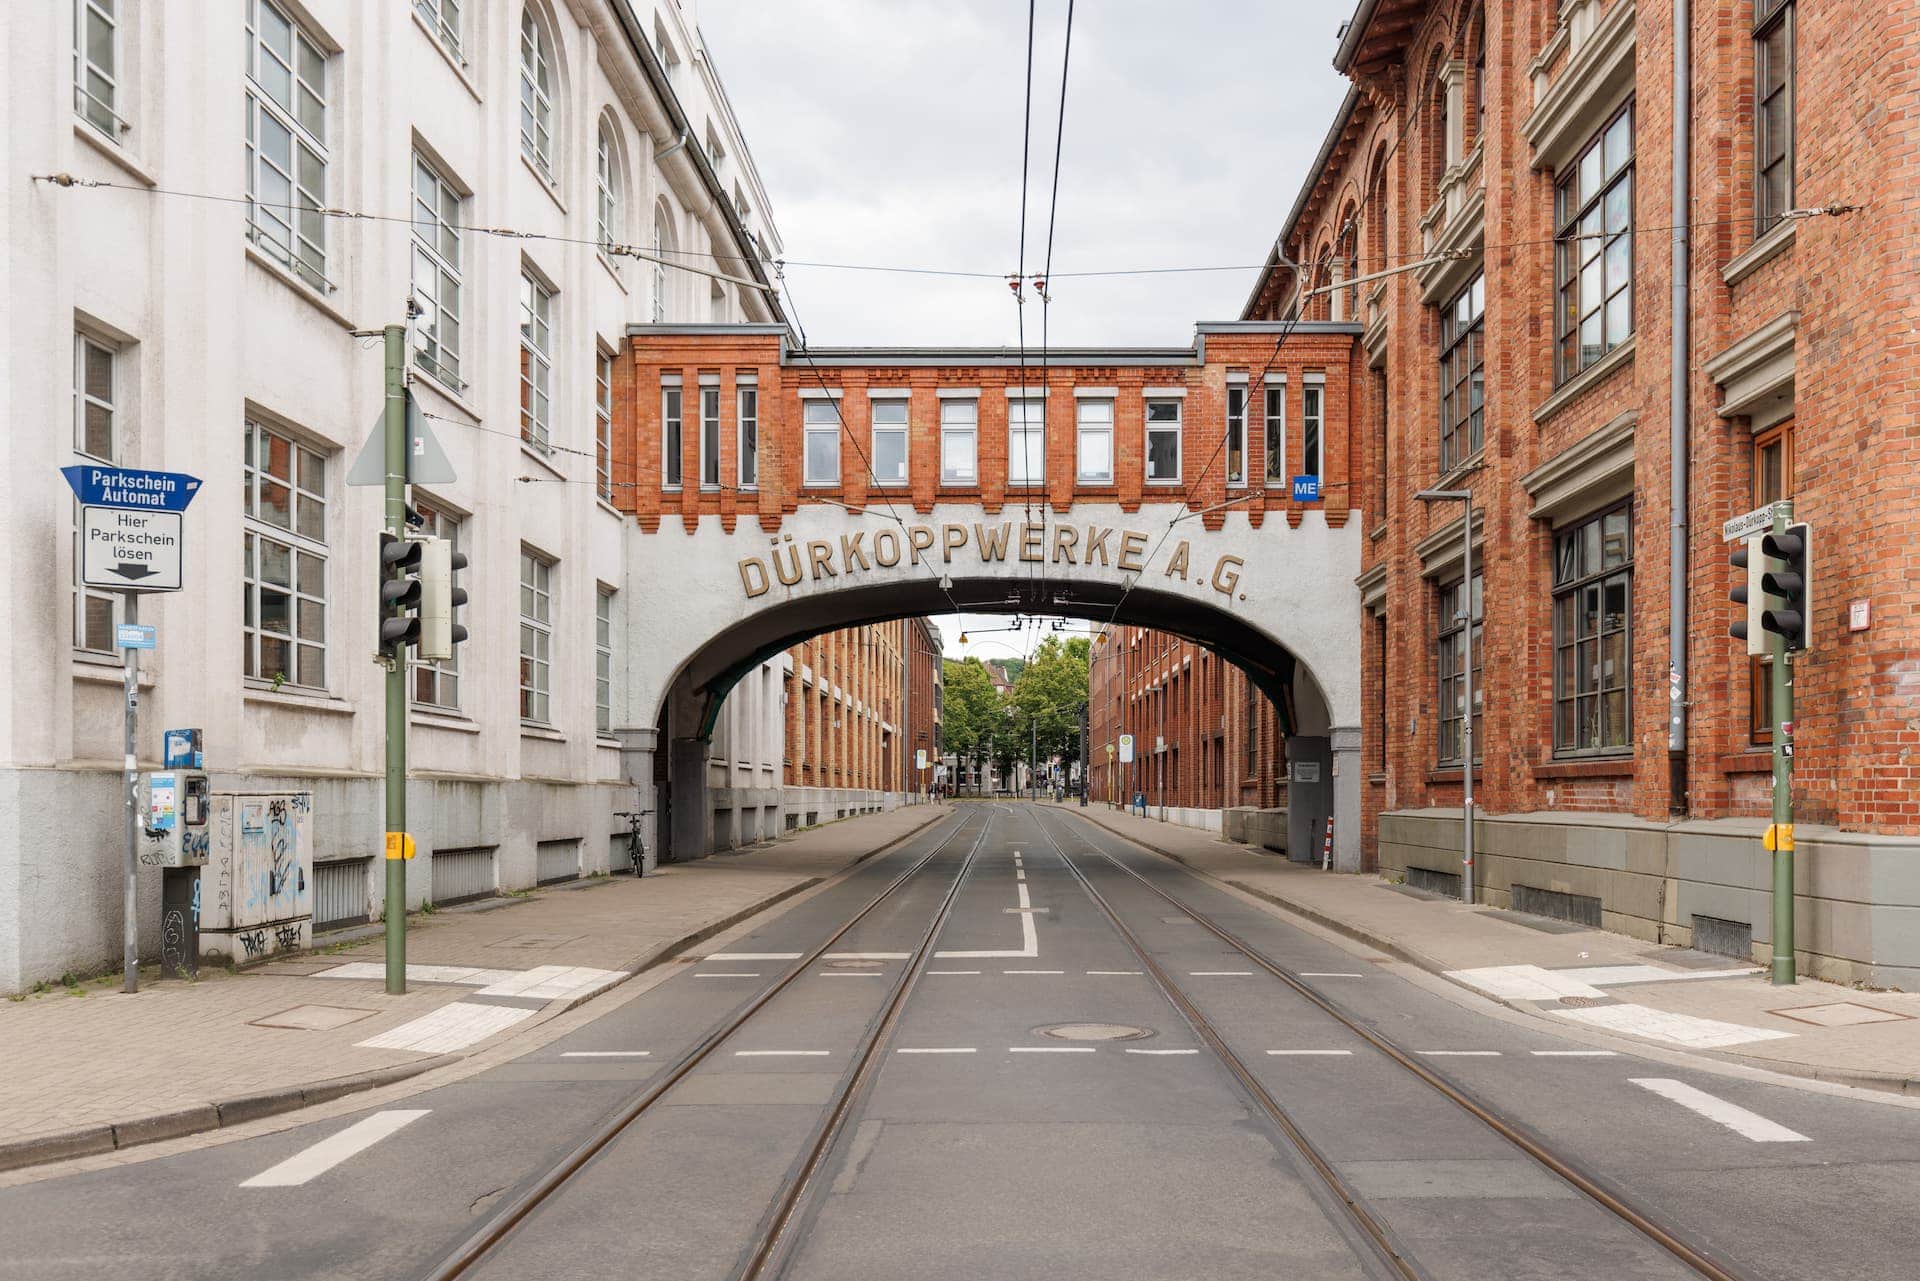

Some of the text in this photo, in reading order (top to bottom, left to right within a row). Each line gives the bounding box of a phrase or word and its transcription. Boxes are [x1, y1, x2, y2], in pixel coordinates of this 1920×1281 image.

[92, 470, 176, 492] Parkschein
[1294, 482, 1317, 495] ME
[102, 487, 166, 506] Automat
[117, 514, 149, 528] Hier
[91, 528, 175, 546] Parkschein
[113, 545, 153, 561] lösen
[738, 521, 1248, 602] DÜRKOPPWERKE A.G.
